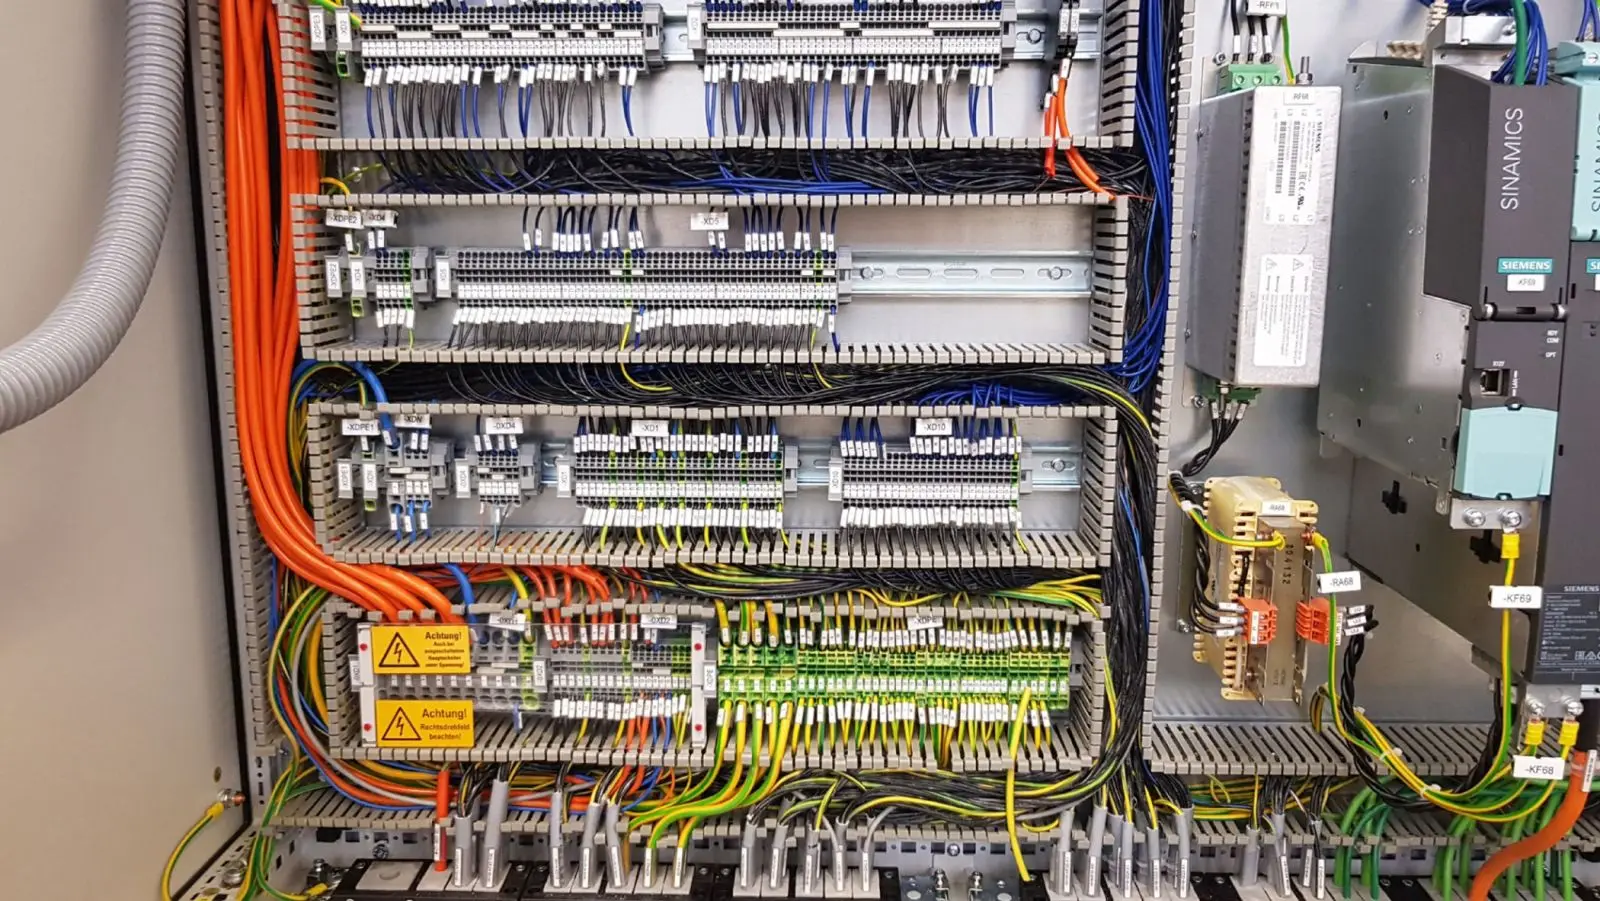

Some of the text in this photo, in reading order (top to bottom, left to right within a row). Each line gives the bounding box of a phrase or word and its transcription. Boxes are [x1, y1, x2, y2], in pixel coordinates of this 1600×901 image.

[1500, 107, 1523, 211] SINAMICS
[1502, 261, 1551, 270] SIEMENS
[347, 423, 374, 431] -XDPE1
[641, 424, 659, 432] -XD1
[923, 423, 947, 431] -XD10
[1329, 576, 1354, 587] -RA68
[1503, 594, 1532, 603] -KF69
[425, 631, 462, 641] Achtung!
[422, 708, 467, 720] Achtung!
[1525, 765, 1554, 775] -KF68
